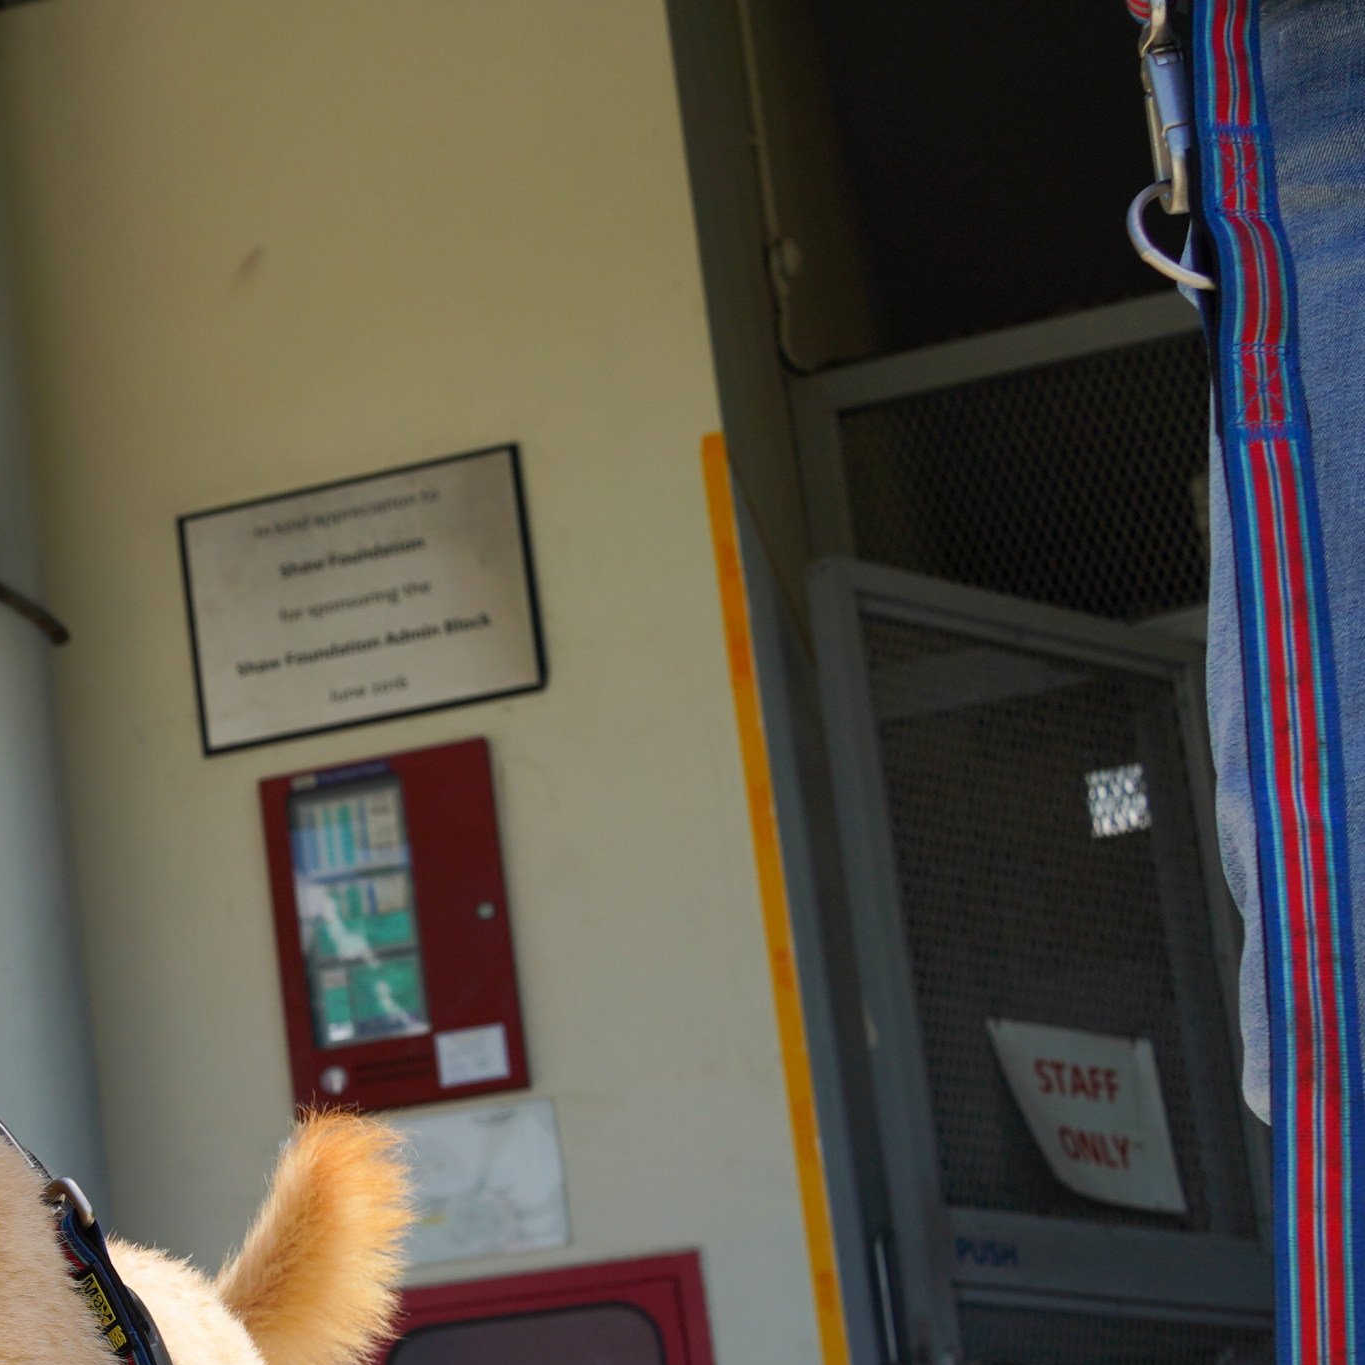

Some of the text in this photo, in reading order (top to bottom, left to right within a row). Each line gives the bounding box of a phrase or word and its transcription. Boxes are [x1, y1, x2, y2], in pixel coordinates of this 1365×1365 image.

[313, 495, 417, 528] appreciation
[278, 536, 426, 580] Shaw Foundation
[278, 580, 432, 623] for sponsoring the
[236, 609, 492, 678] Shaw Foundation Admin Block
[1033, 1056, 1119, 1104] STAFF
[1057, 1125, 1131, 1170] ONLY
[954, 1236, 1020, 1269] PUSH
